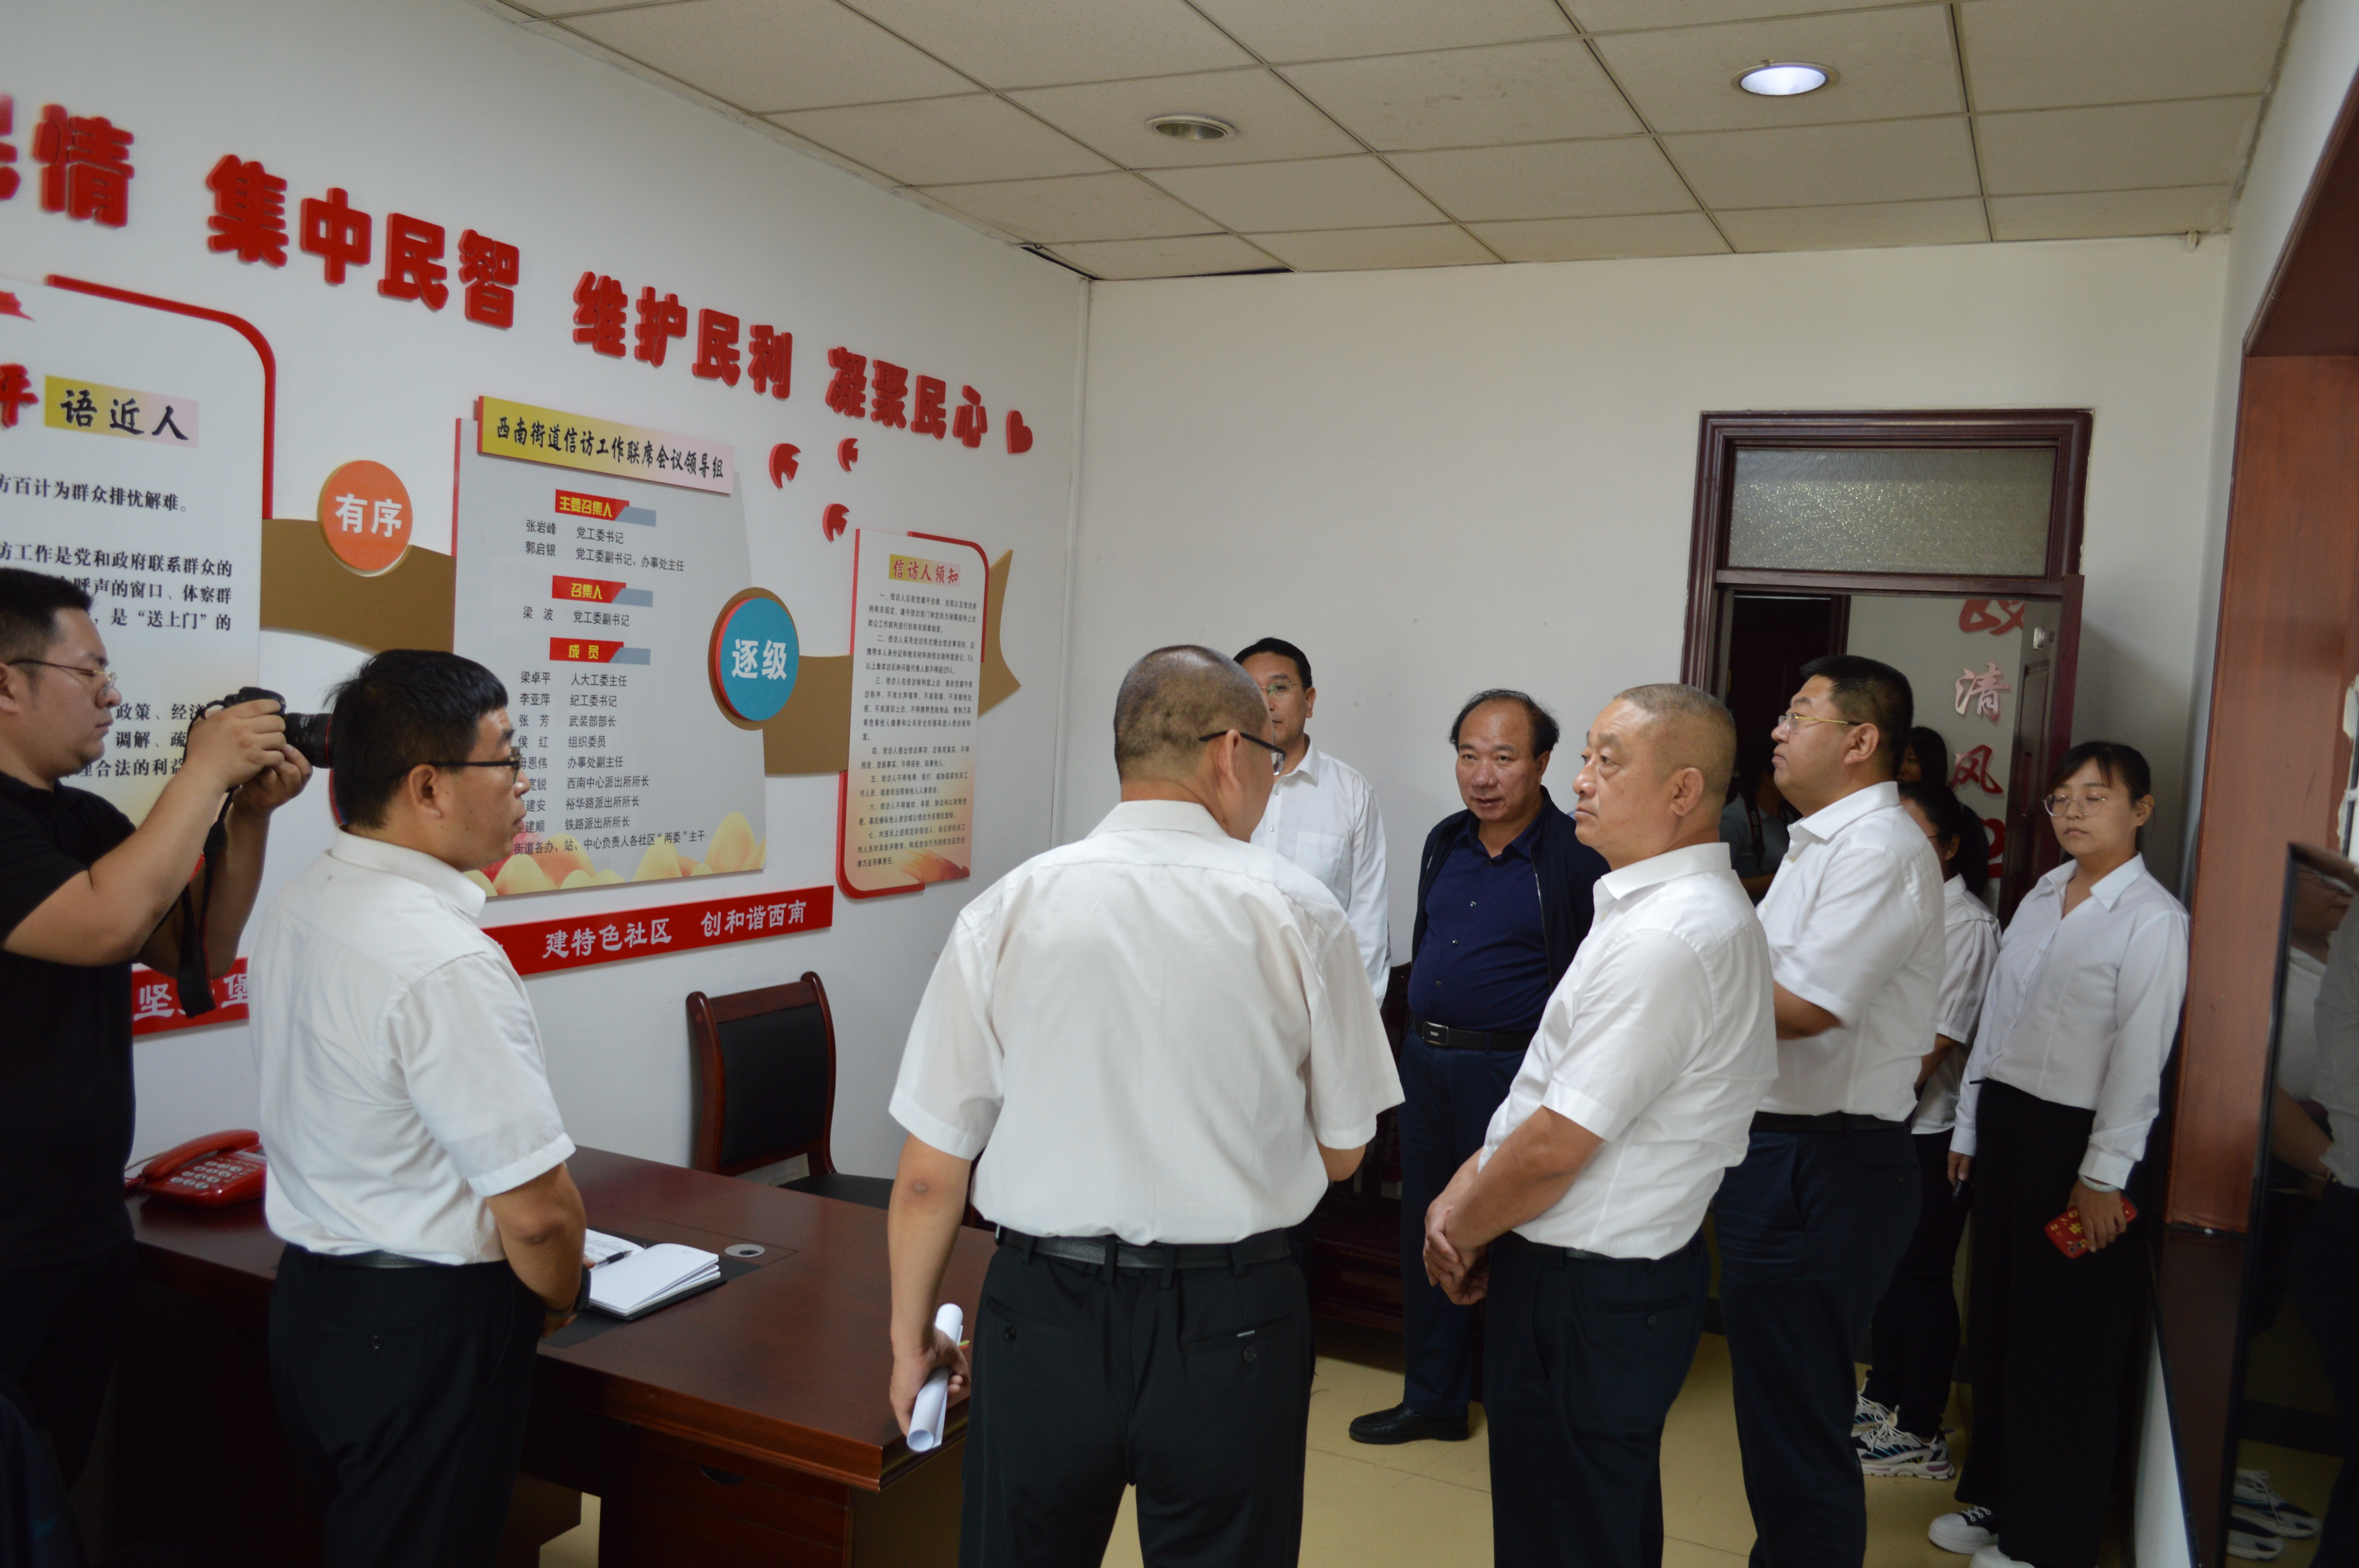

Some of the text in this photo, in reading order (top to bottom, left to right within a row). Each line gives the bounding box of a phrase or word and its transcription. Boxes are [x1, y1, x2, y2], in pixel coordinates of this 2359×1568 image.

[0, 91, 988, 448] 情 集中民智 维护民利 凝聚民心
[60, 389, 189, 440] 语近人
[497, 417, 723, 479] 西南街道信访工作联席会议领导组
[336, 493, 402, 537] 有序
[560, 496, 612, 517] 主要召集人
[526, 520, 624, 544] 张岩峰 党工委书记
[526, 541, 685, 572] 郭启银 党工委副书记、办事处主任
[893, 559, 959, 584] 信访人须知
[60, 575, 232, 604] 呼声的窗口、体察群
[571, 583, 602, 600] 召集人
[574, 610, 629, 626] 党工委副书记
[569, 644, 599, 659] 成员
[732, 639, 787, 681] 逐级
[521, 671, 627, 687] 梁卓平 人大工委主任
[520, 693, 617, 707] 李亚萍 纪工委书记
[519, 715, 616, 727] 张芳 武装部部长
[518, 735, 606, 748] 侯红 组织委员
[66, 758, 184, 777] 理合法的利益
[567, 756, 623, 769] 办事处副主任
[567, 775, 649, 789] 西南中心派出所所长
[523, 795, 640, 812] 建安 裕华路派出所所长
[519, 816, 630, 833] 建顺 铁路派出所所长
[542, 899, 807, 959] 建特色社区 创和谐西南
[134, 973, 249, 1021] 坚堡
